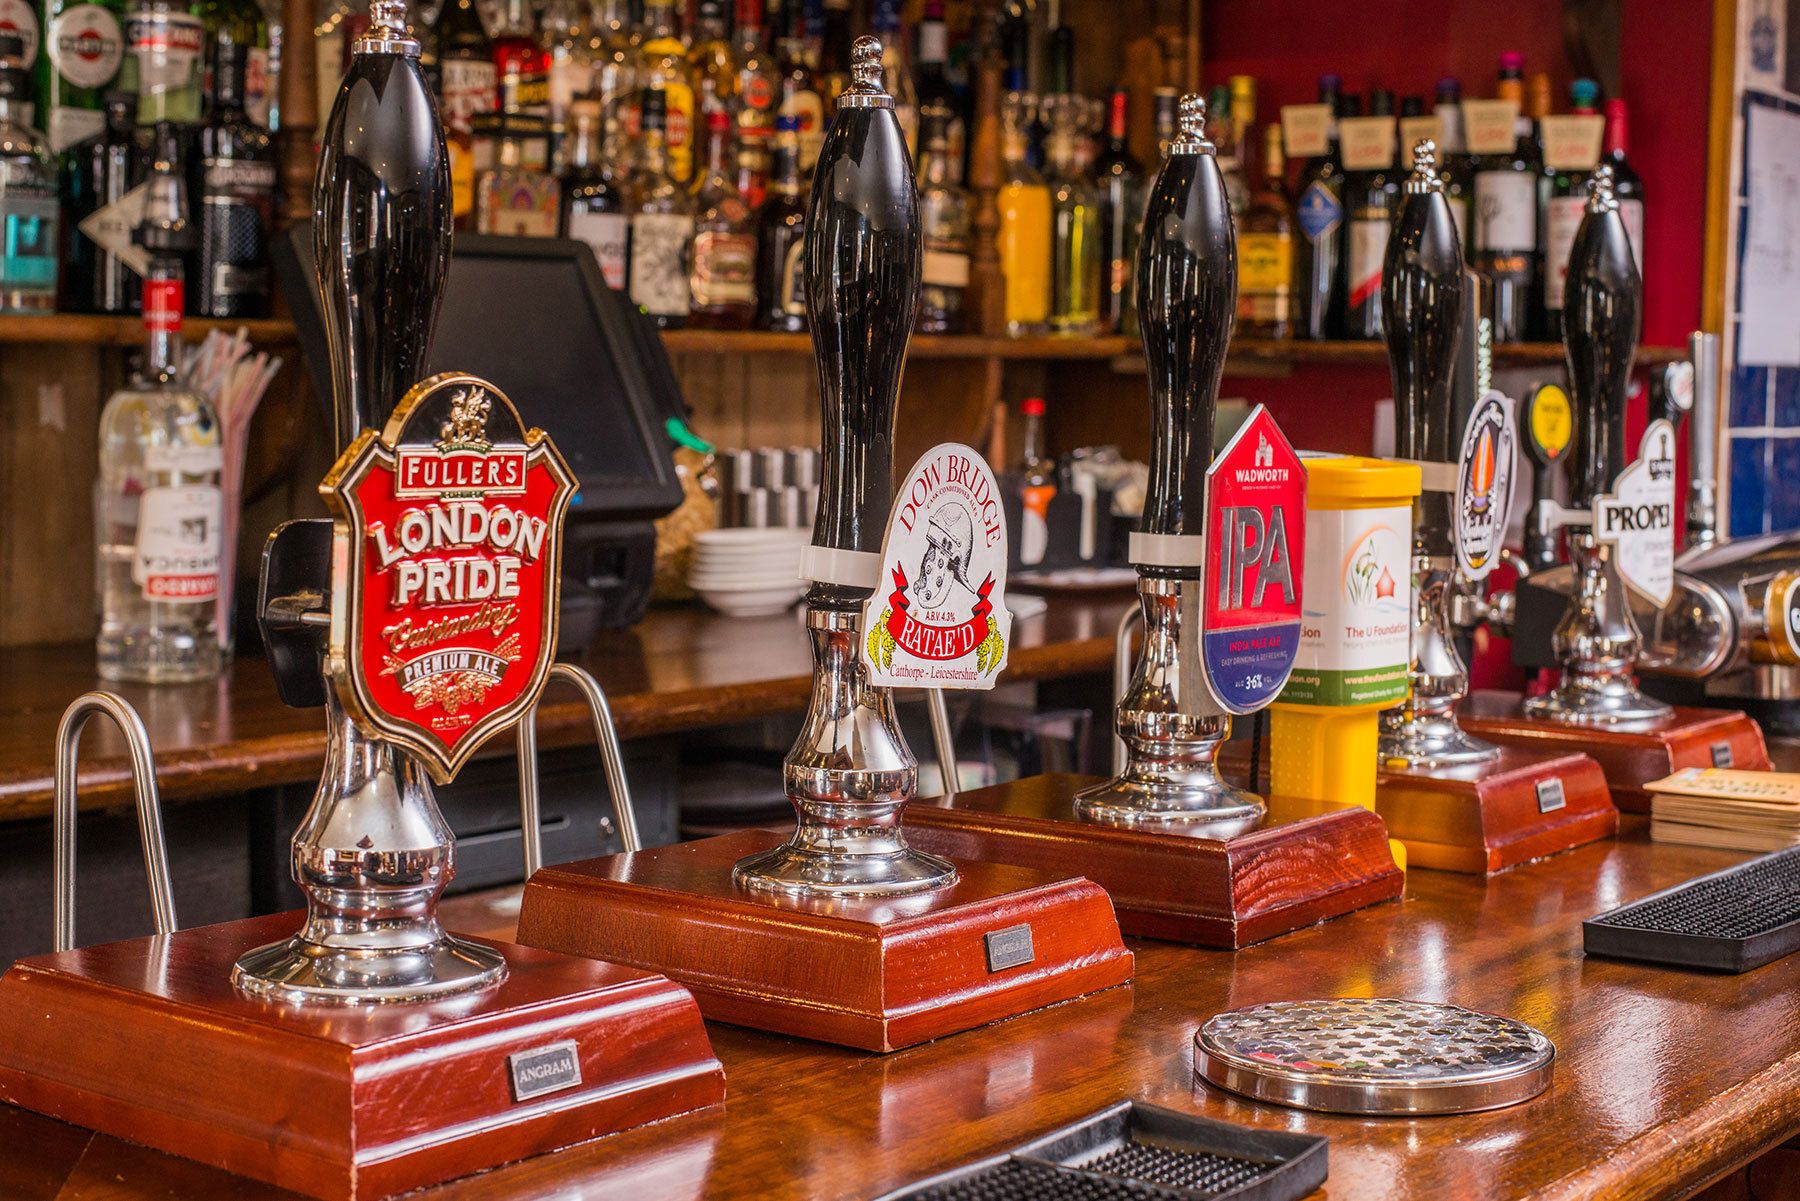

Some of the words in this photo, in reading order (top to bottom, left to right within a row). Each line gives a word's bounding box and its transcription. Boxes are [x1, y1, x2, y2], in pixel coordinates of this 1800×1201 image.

[406, 456, 518, 486] FULLER'S
[1235, 468, 1289, 483] WADWORTH
[899, 456, 942, 536] DOW
[946, 454, 1002, 549] BRIDGE
[369, 502, 547, 568] LONDON
[1218, 504, 1296, 612] IPA
[395, 557, 521, 605] PRIDE
[382, 602, 520, 654] Outstanding
[898, 615, 975, 657] RATAE'D
[1268, 635, 1281, 648] ALE
[1345, 626, 1365, 638] The
[1366, 626, 1373, 637] U
[403, 653, 471, 682] PREMIUM
[474, 655, 501, 676] ALE
[930, 665, 979, 681] Leicestershire
[520, 1057, 573, 1084] ANGRAM
